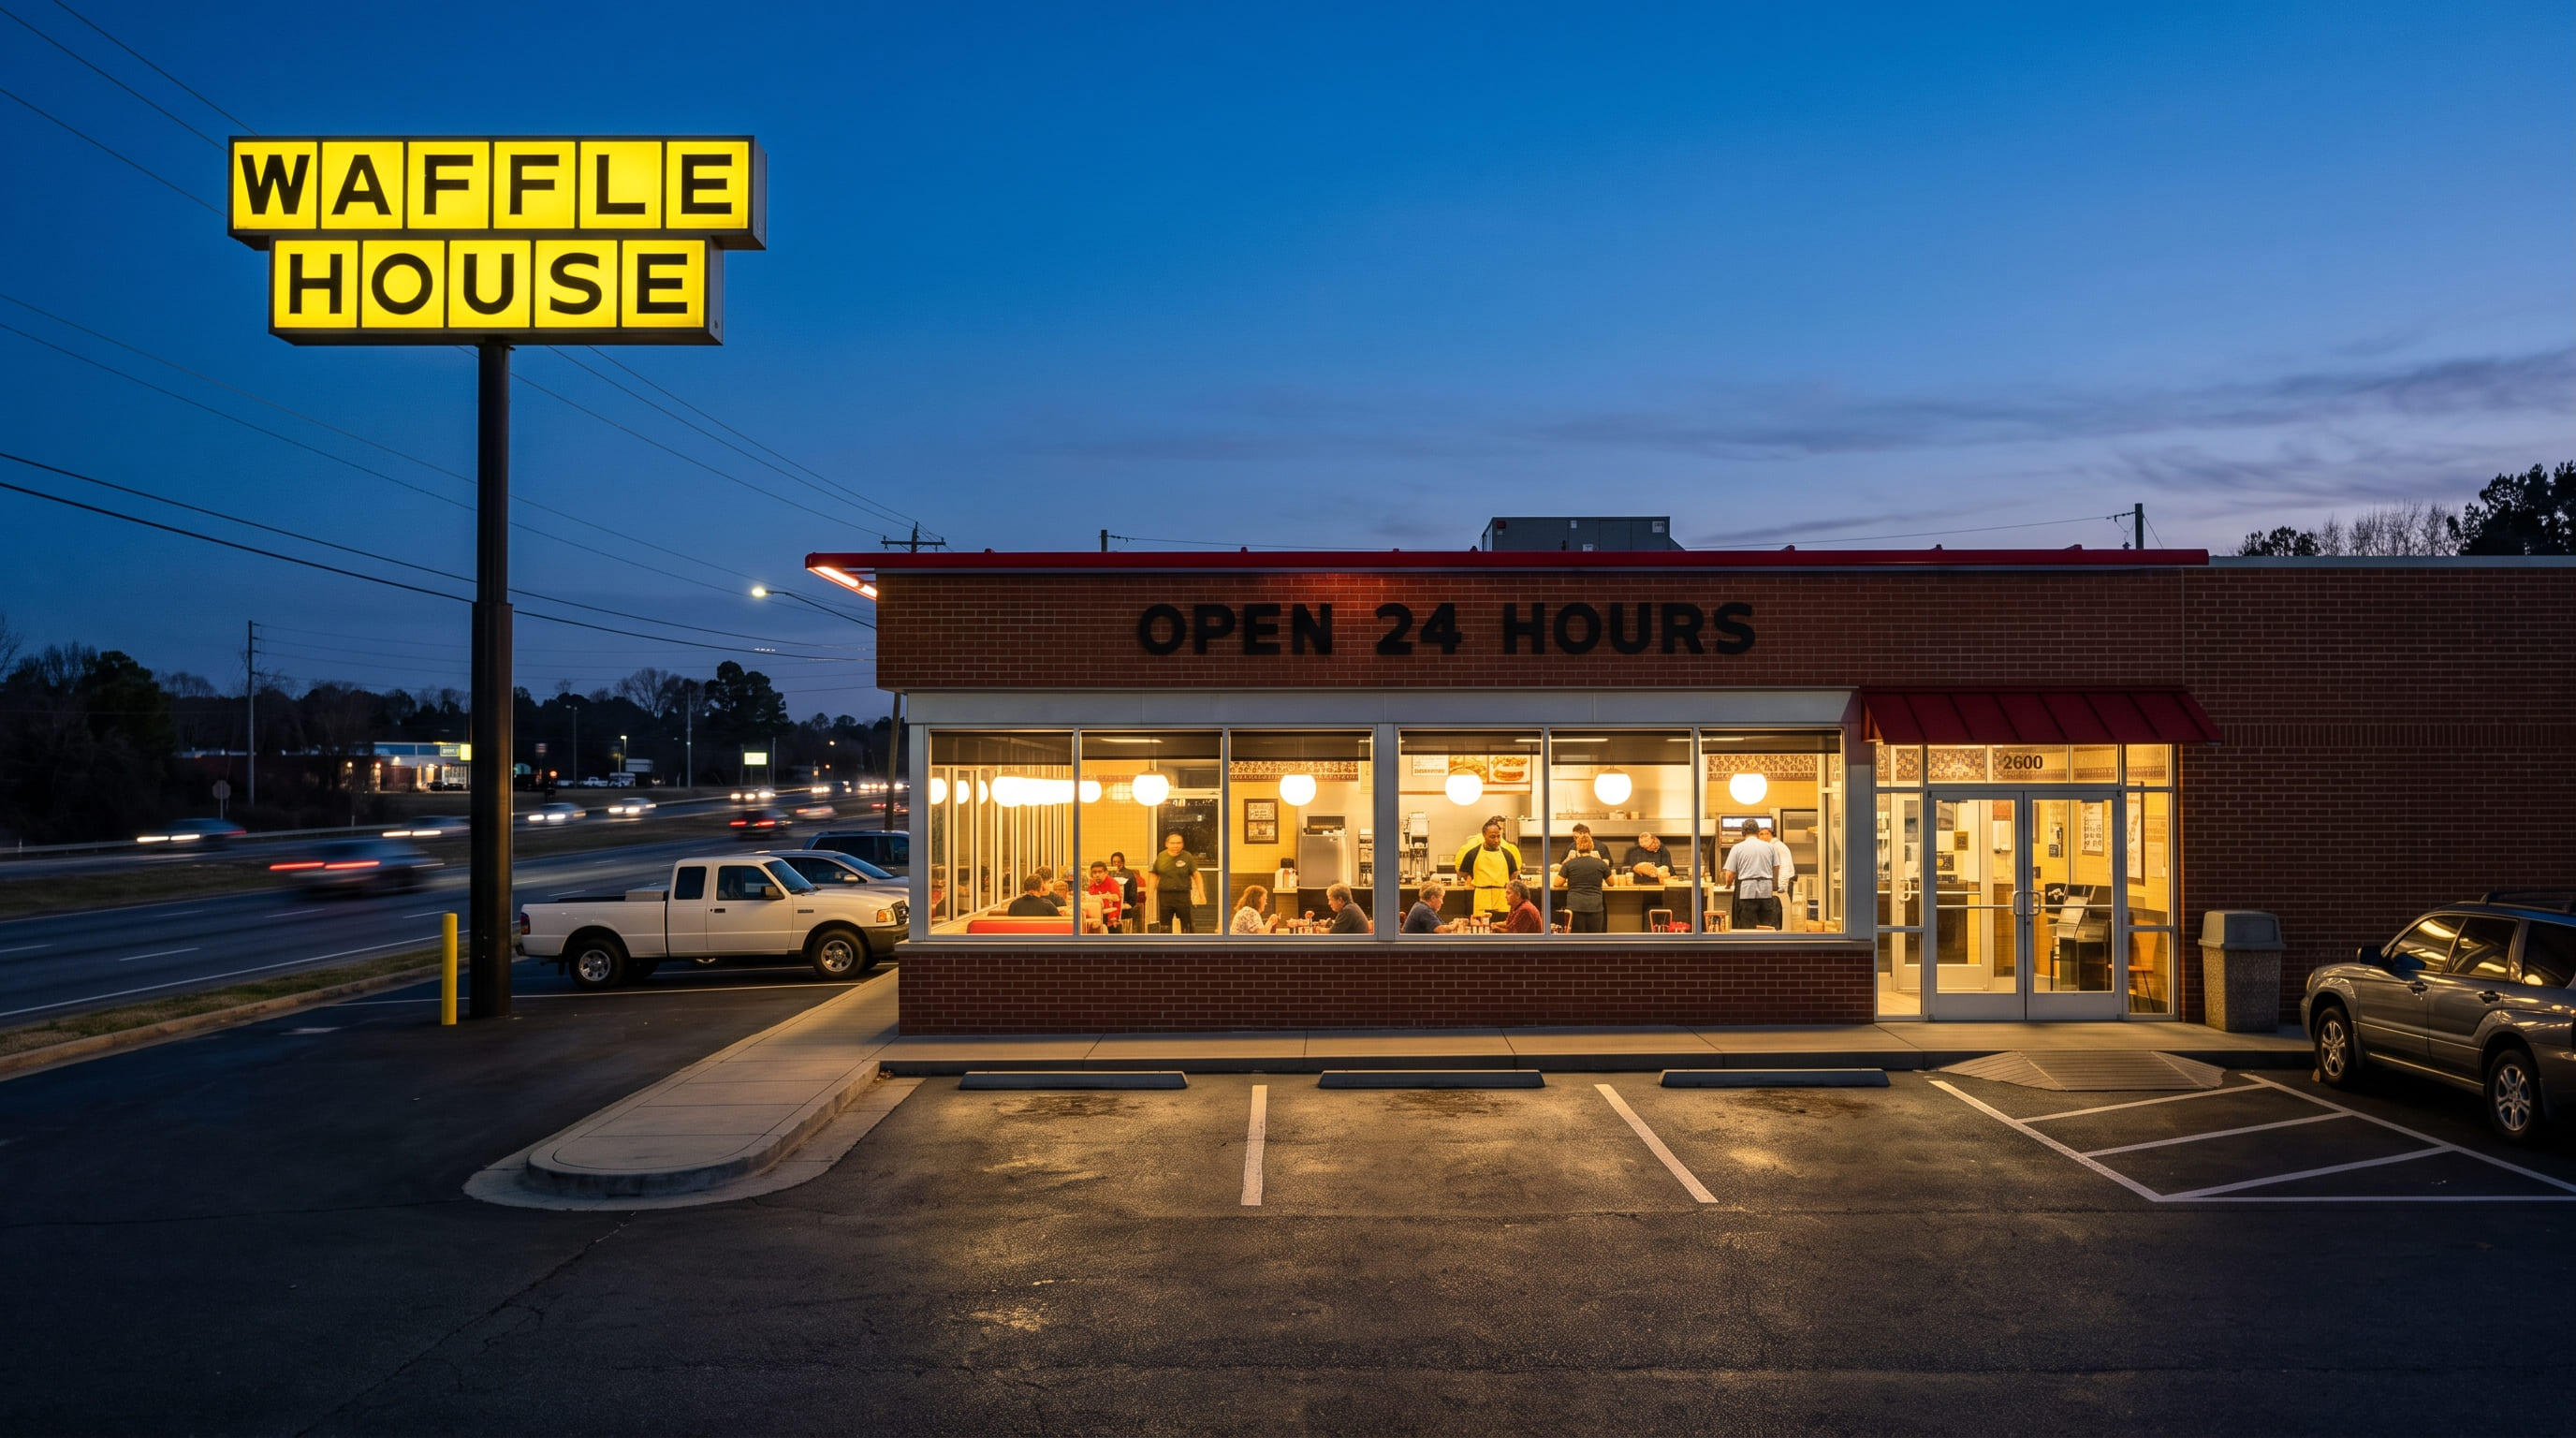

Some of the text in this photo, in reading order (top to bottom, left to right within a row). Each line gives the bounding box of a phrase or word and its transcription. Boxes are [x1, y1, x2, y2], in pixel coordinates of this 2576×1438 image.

[240, 154, 733, 215] WAFFLE
[289, 252, 688, 315] HOUSE
[1137, 602, 1757, 656] OPEN 24 HOURS
[2003, 755, 2043, 770] 2600
